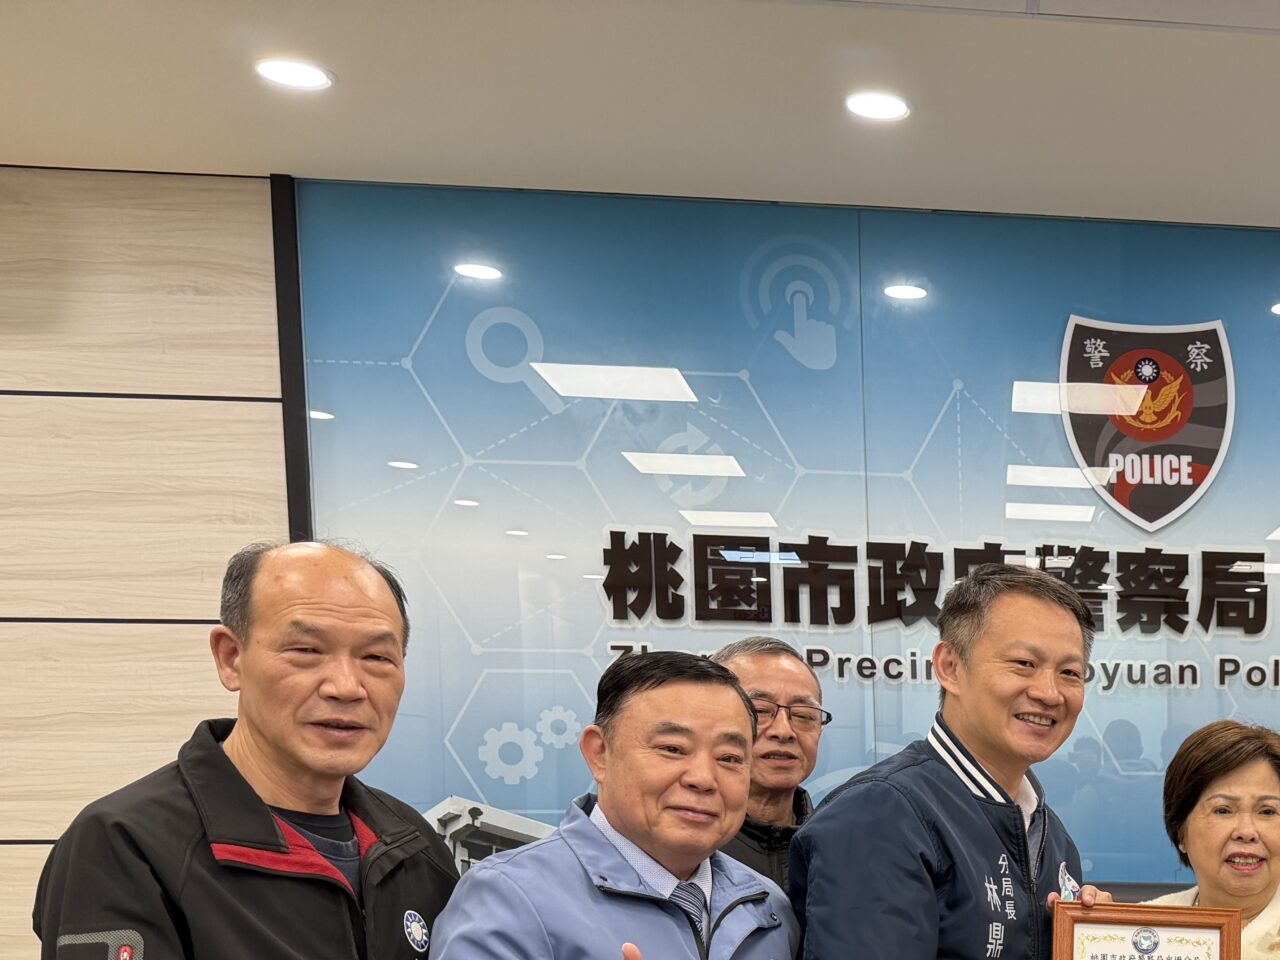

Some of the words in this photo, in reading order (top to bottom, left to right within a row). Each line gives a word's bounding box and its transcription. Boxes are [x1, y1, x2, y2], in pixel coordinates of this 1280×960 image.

[1083, 338, 1110, 369] 警
[1187, 341, 1214, 372] 察
[1108, 453, 1193, 486] POLICE
[998, 853, 1017, 920] 分局長
